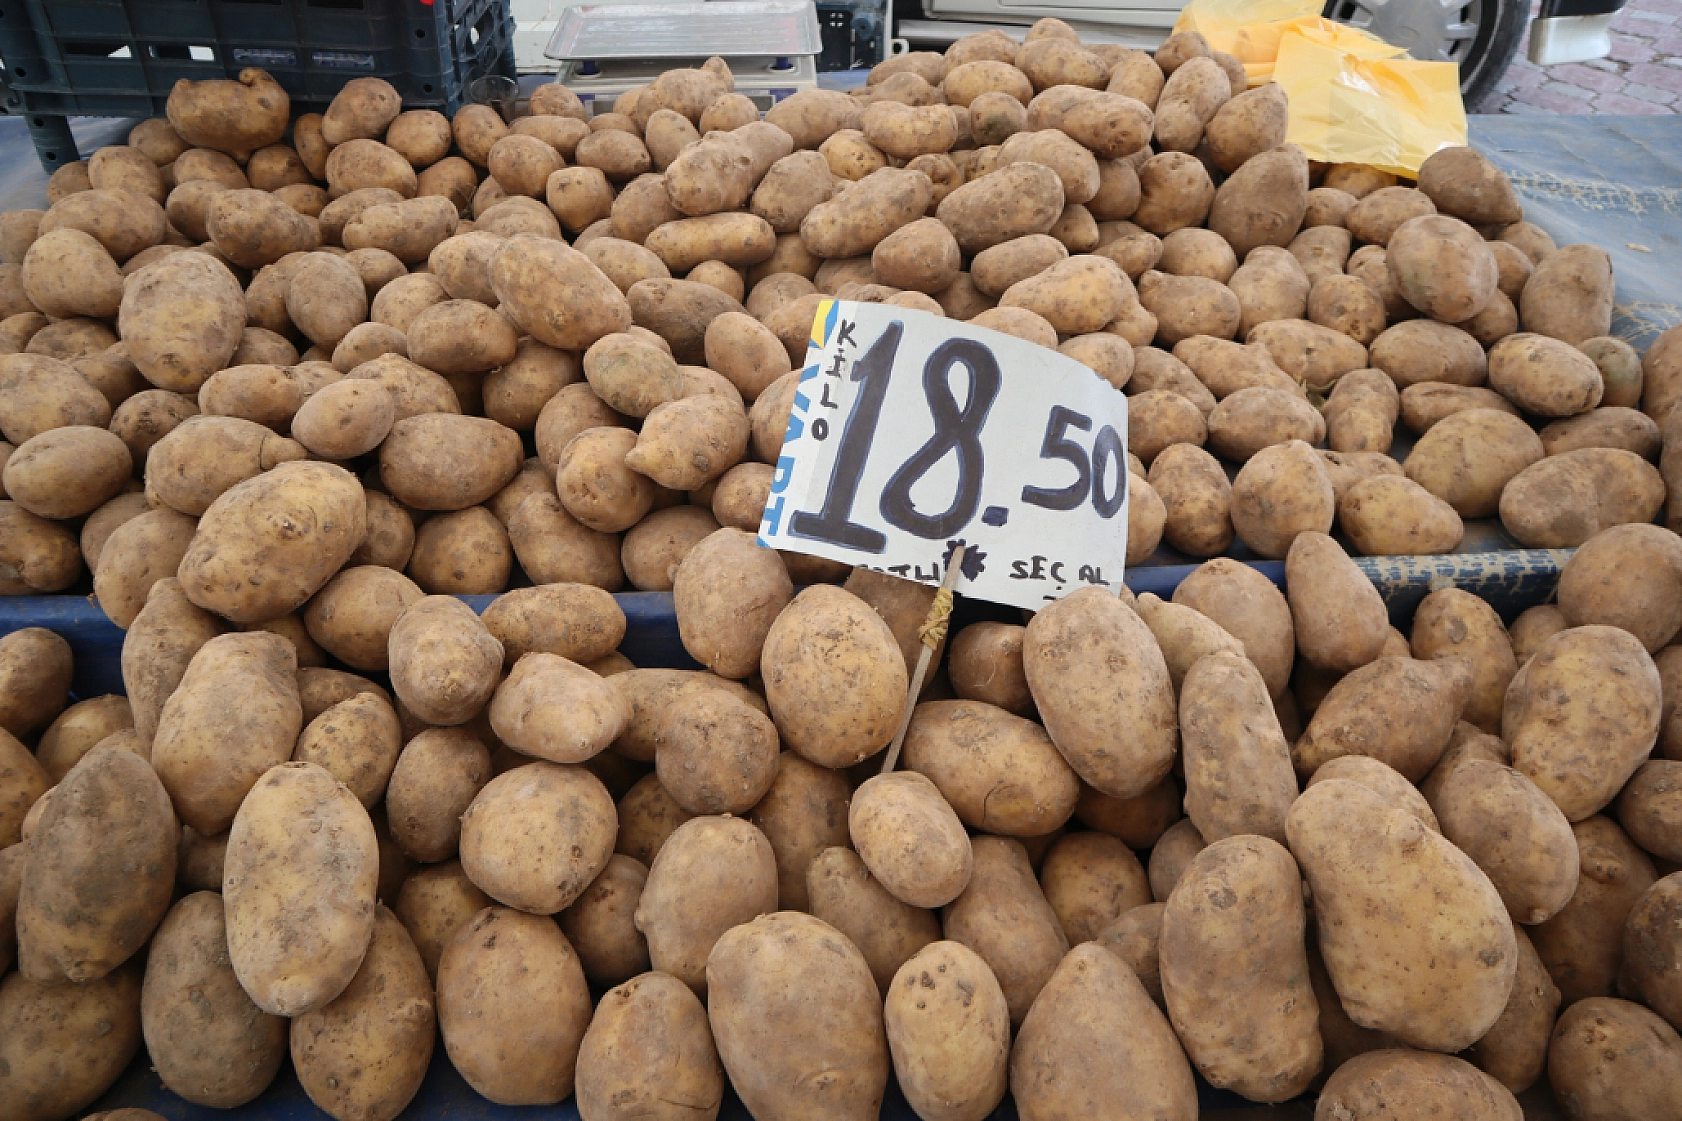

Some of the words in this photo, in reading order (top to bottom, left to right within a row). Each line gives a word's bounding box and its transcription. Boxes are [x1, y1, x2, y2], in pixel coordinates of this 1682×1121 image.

[787, 319, 1126, 555] 18.50
[1009, 554, 1067, 591] SEÇ
[1078, 563, 1111, 587] AL
